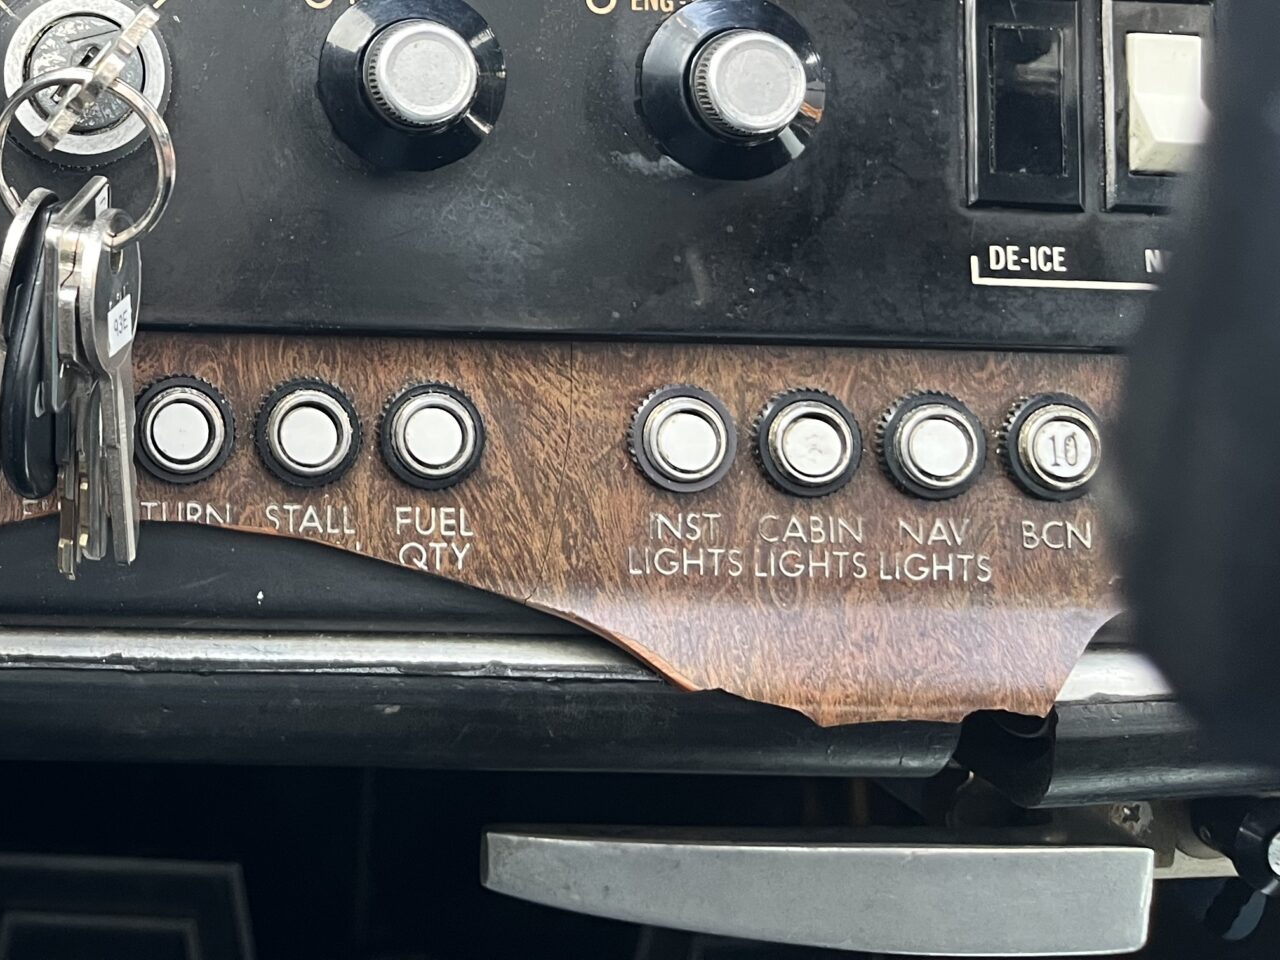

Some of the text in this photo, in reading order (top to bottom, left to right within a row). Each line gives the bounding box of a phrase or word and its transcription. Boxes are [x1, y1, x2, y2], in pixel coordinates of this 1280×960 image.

[988, 245, 1067, 272] DE-ICE
[1048, 431, 1080, 468] 10
[140, 501, 230, 525] TURN
[265, 505, 355, 534] STALL
[396, 506, 473, 536] FUEL
[649, 512, 721, 541] INST
[758, 515, 863, 543] CABIN
[898, 518, 970, 546] NAV
[1022, 520, 1092, 550] BCN
[399, 542, 470, 570] QTY
[628, 547, 743, 577] LIGHTS
[755, 549, 868, 578] LIGHTS
[879, 553, 992, 582] LIGHTS
